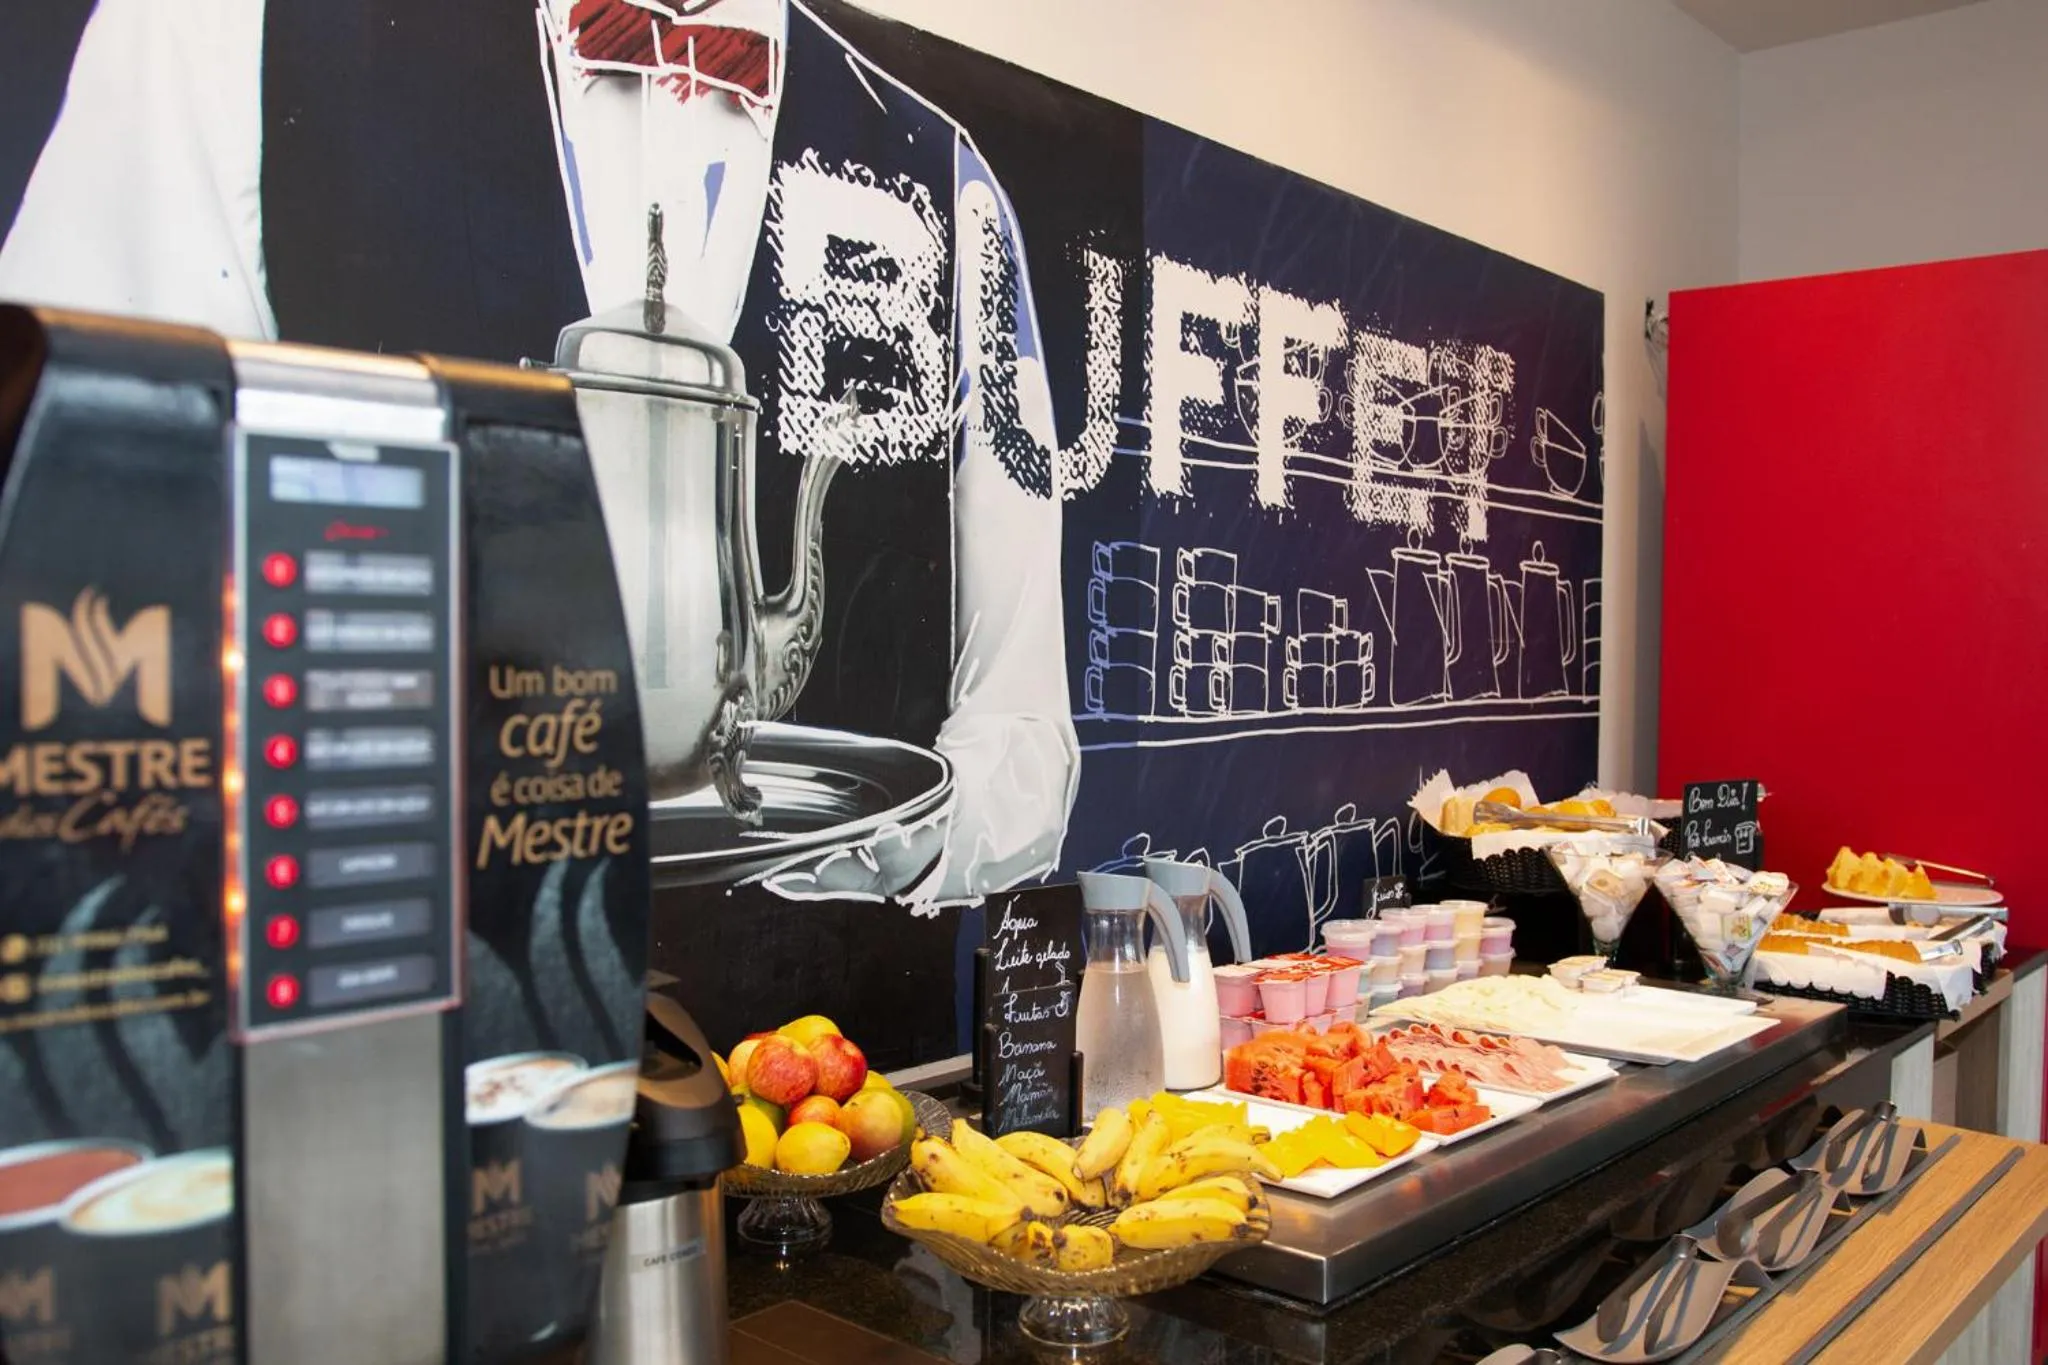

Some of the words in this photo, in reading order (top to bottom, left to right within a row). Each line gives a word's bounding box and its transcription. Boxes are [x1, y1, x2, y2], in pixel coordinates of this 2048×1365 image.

[763, 147, 1516, 544] BUFFET
[489, 664, 545, 699] Um
[553, 664, 618, 697] bom
[500, 697, 603, 769] café
[490, 770, 512, 807] é
[513, 773, 585, 805] coisa
[586, 765, 623, 799] de
[475, 809, 635, 870] Mestre
[992, 894, 1039, 941] Água
[995, 936, 1034, 972] Leite
[1035, 939, 1071, 970] gelado
[1003, 993, 1051, 1025] Frutas
[998, 1031, 1058, 1059] Banana
